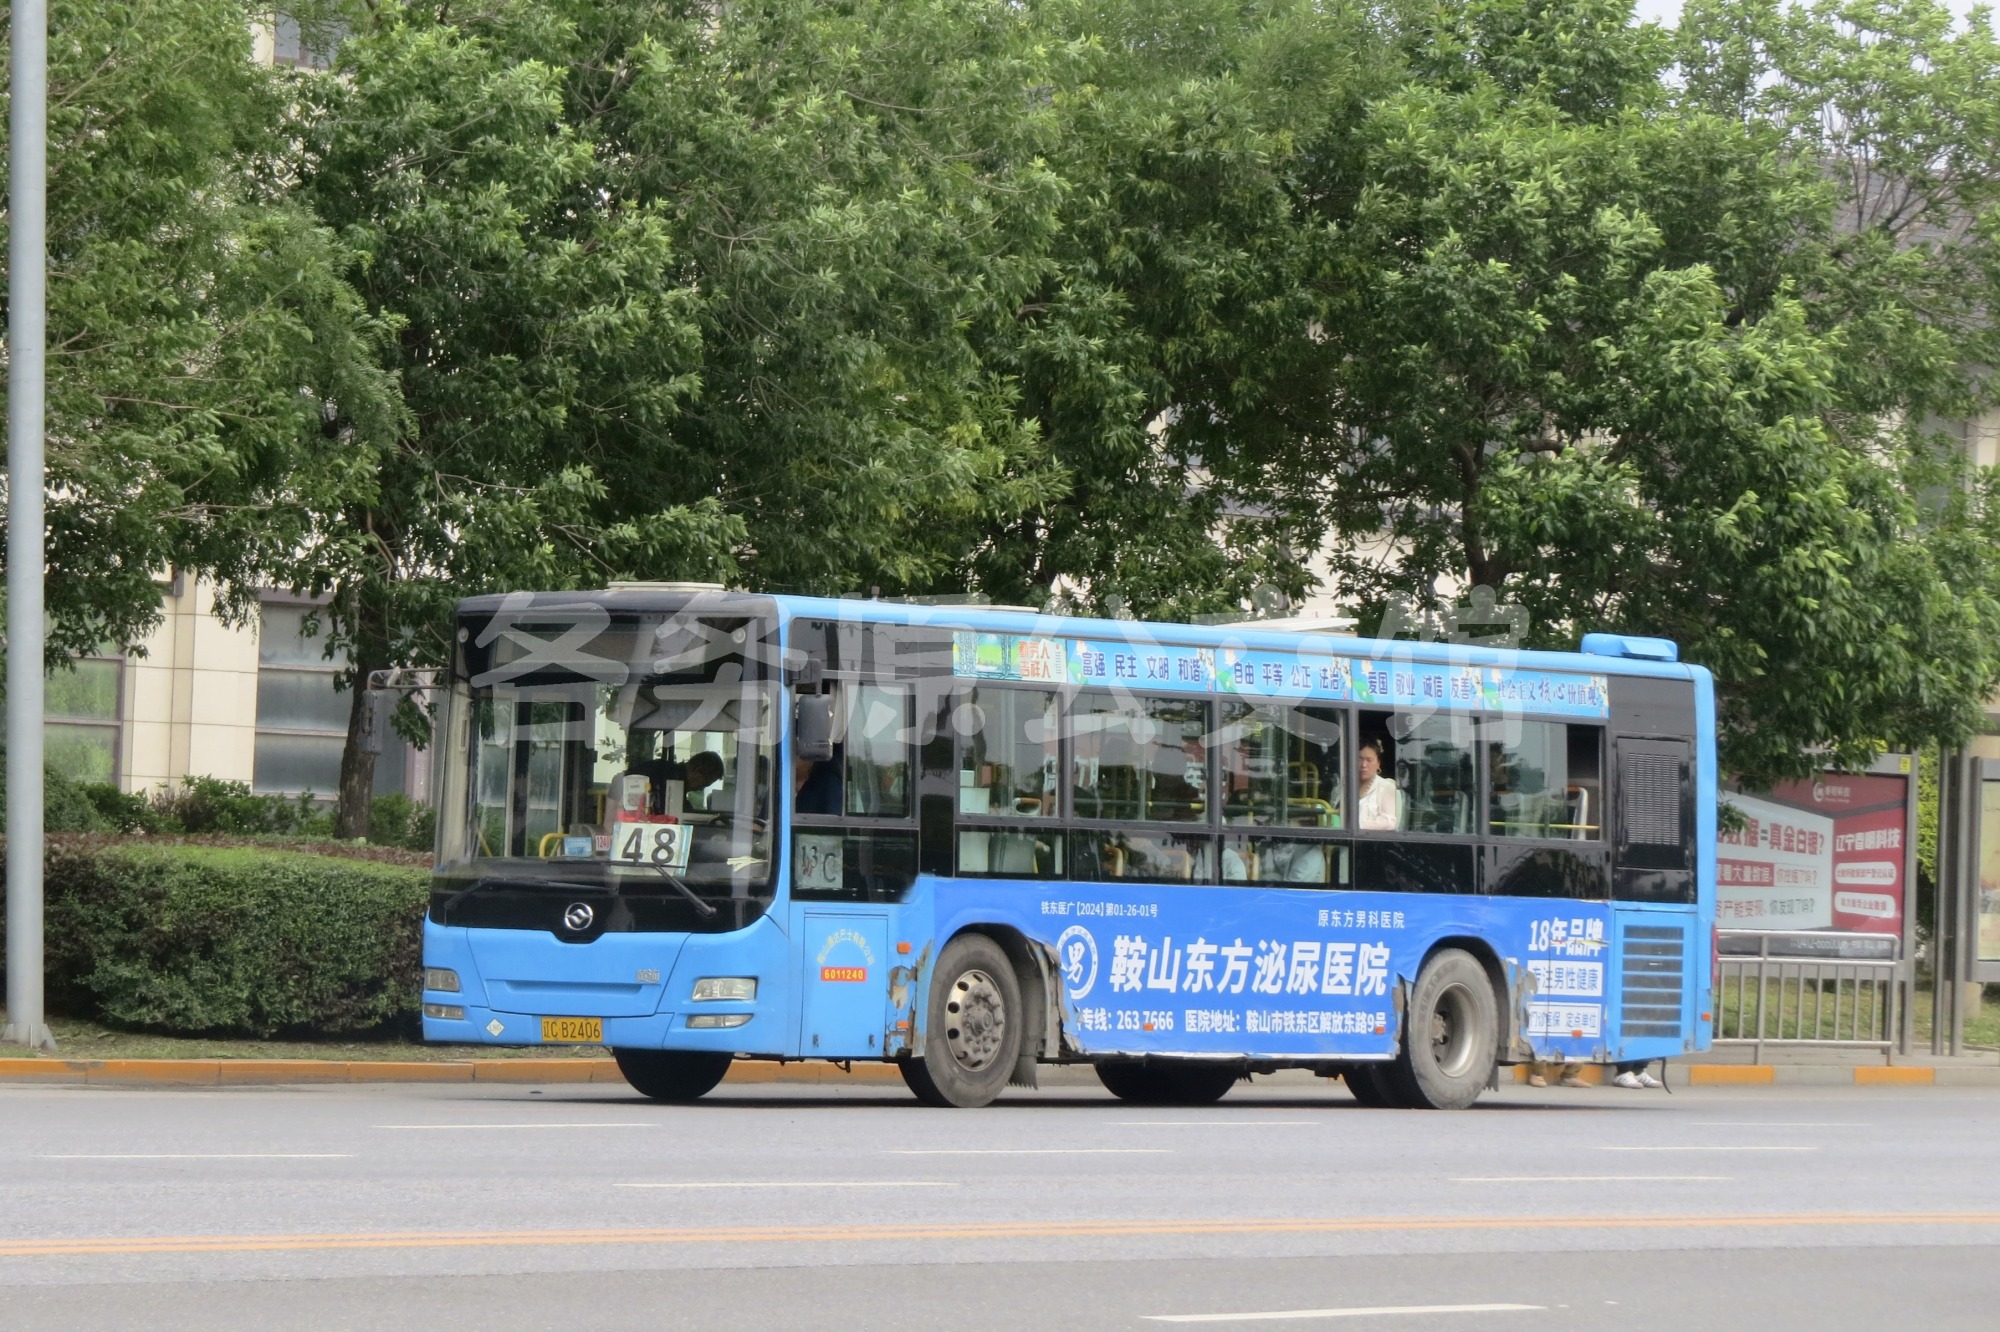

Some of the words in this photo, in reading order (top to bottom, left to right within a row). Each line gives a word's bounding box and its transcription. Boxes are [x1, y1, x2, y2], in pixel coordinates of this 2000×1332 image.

[1020, 660, 1052, 679] 吉祥人
[1082, 652, 1106, 677] 富强
[1115, 654, 1138, 678] 民主
[1146, 656, 1169, 680] 文明
[1178, 658, 1201, 682] 和谐
[1234, 661, 1254, 685] 自由
[1262, 663, 1283, 687] 平等
[1291, 665, 1311, 689] 公正
[1319, 666, 1340, 690] 法治
[1368, 671, 1388, 695] 爱国
[1395, 673, 1415, 696] 敬业
[1423, 674, 1443, 698] 诚信
[1450, 676, 1470, 700] 友善
[621, 827, 675, 865] 48
[1318, 909, 1405, 929] 原东方男科医院
[824, 969, 864, 980] 6011240
[1067, 941, 1086, 984] 男
[1109, 935, 1391, 996] 鞍山东方泌尿医院
